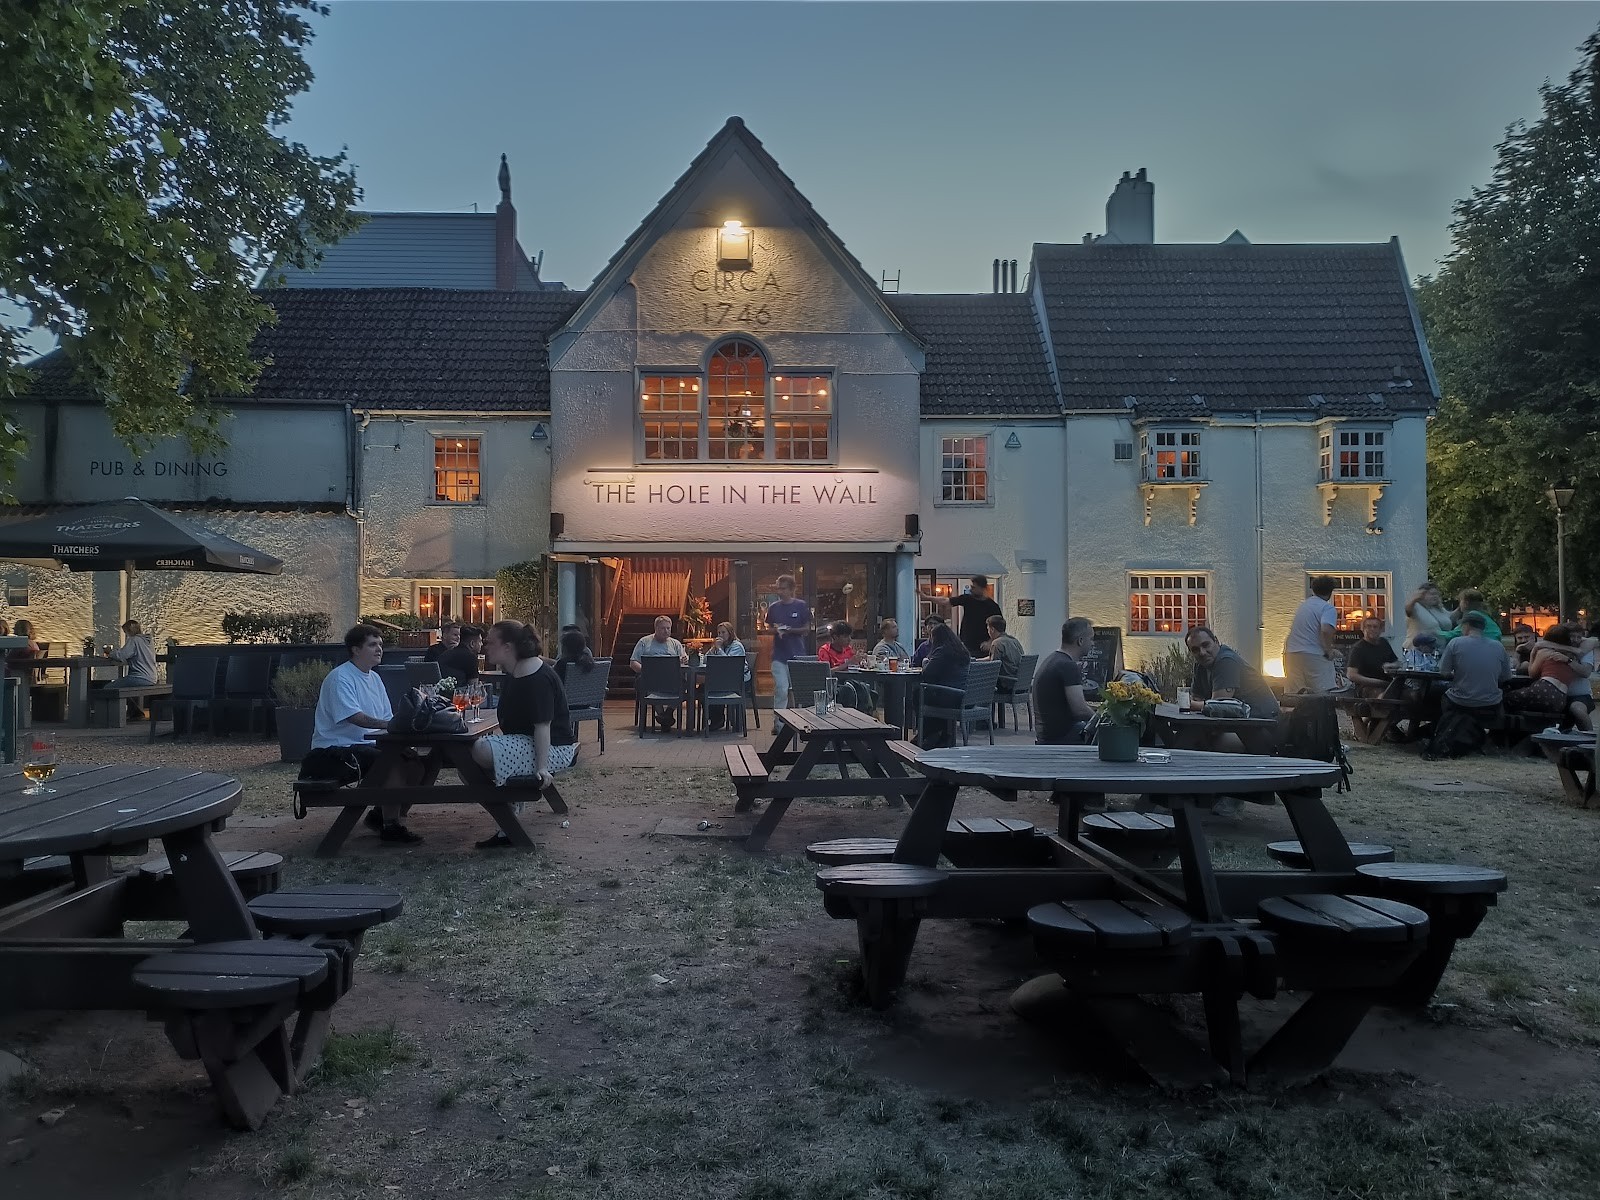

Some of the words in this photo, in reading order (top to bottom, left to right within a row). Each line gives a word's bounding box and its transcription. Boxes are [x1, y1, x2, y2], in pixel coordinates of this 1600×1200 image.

[692, 269, 782, 292] CIRCA
[702, 301, 772, 325] 1746
[90, 461, 124, 476] PUB
[133, 461, 145, 476] &
[154, 461, 228, 477] DINING
[592, 484, 636, 504] THE
[648, 484, 710, 504] HOLE
[722, 485, 747, 504] IN
[758, 485, 801, 504] THE
[812, 485, 877, 504] WALL
[56, 521, 141, 532] THATCHERS
[52, 544, 100, 554] THATCHERS
